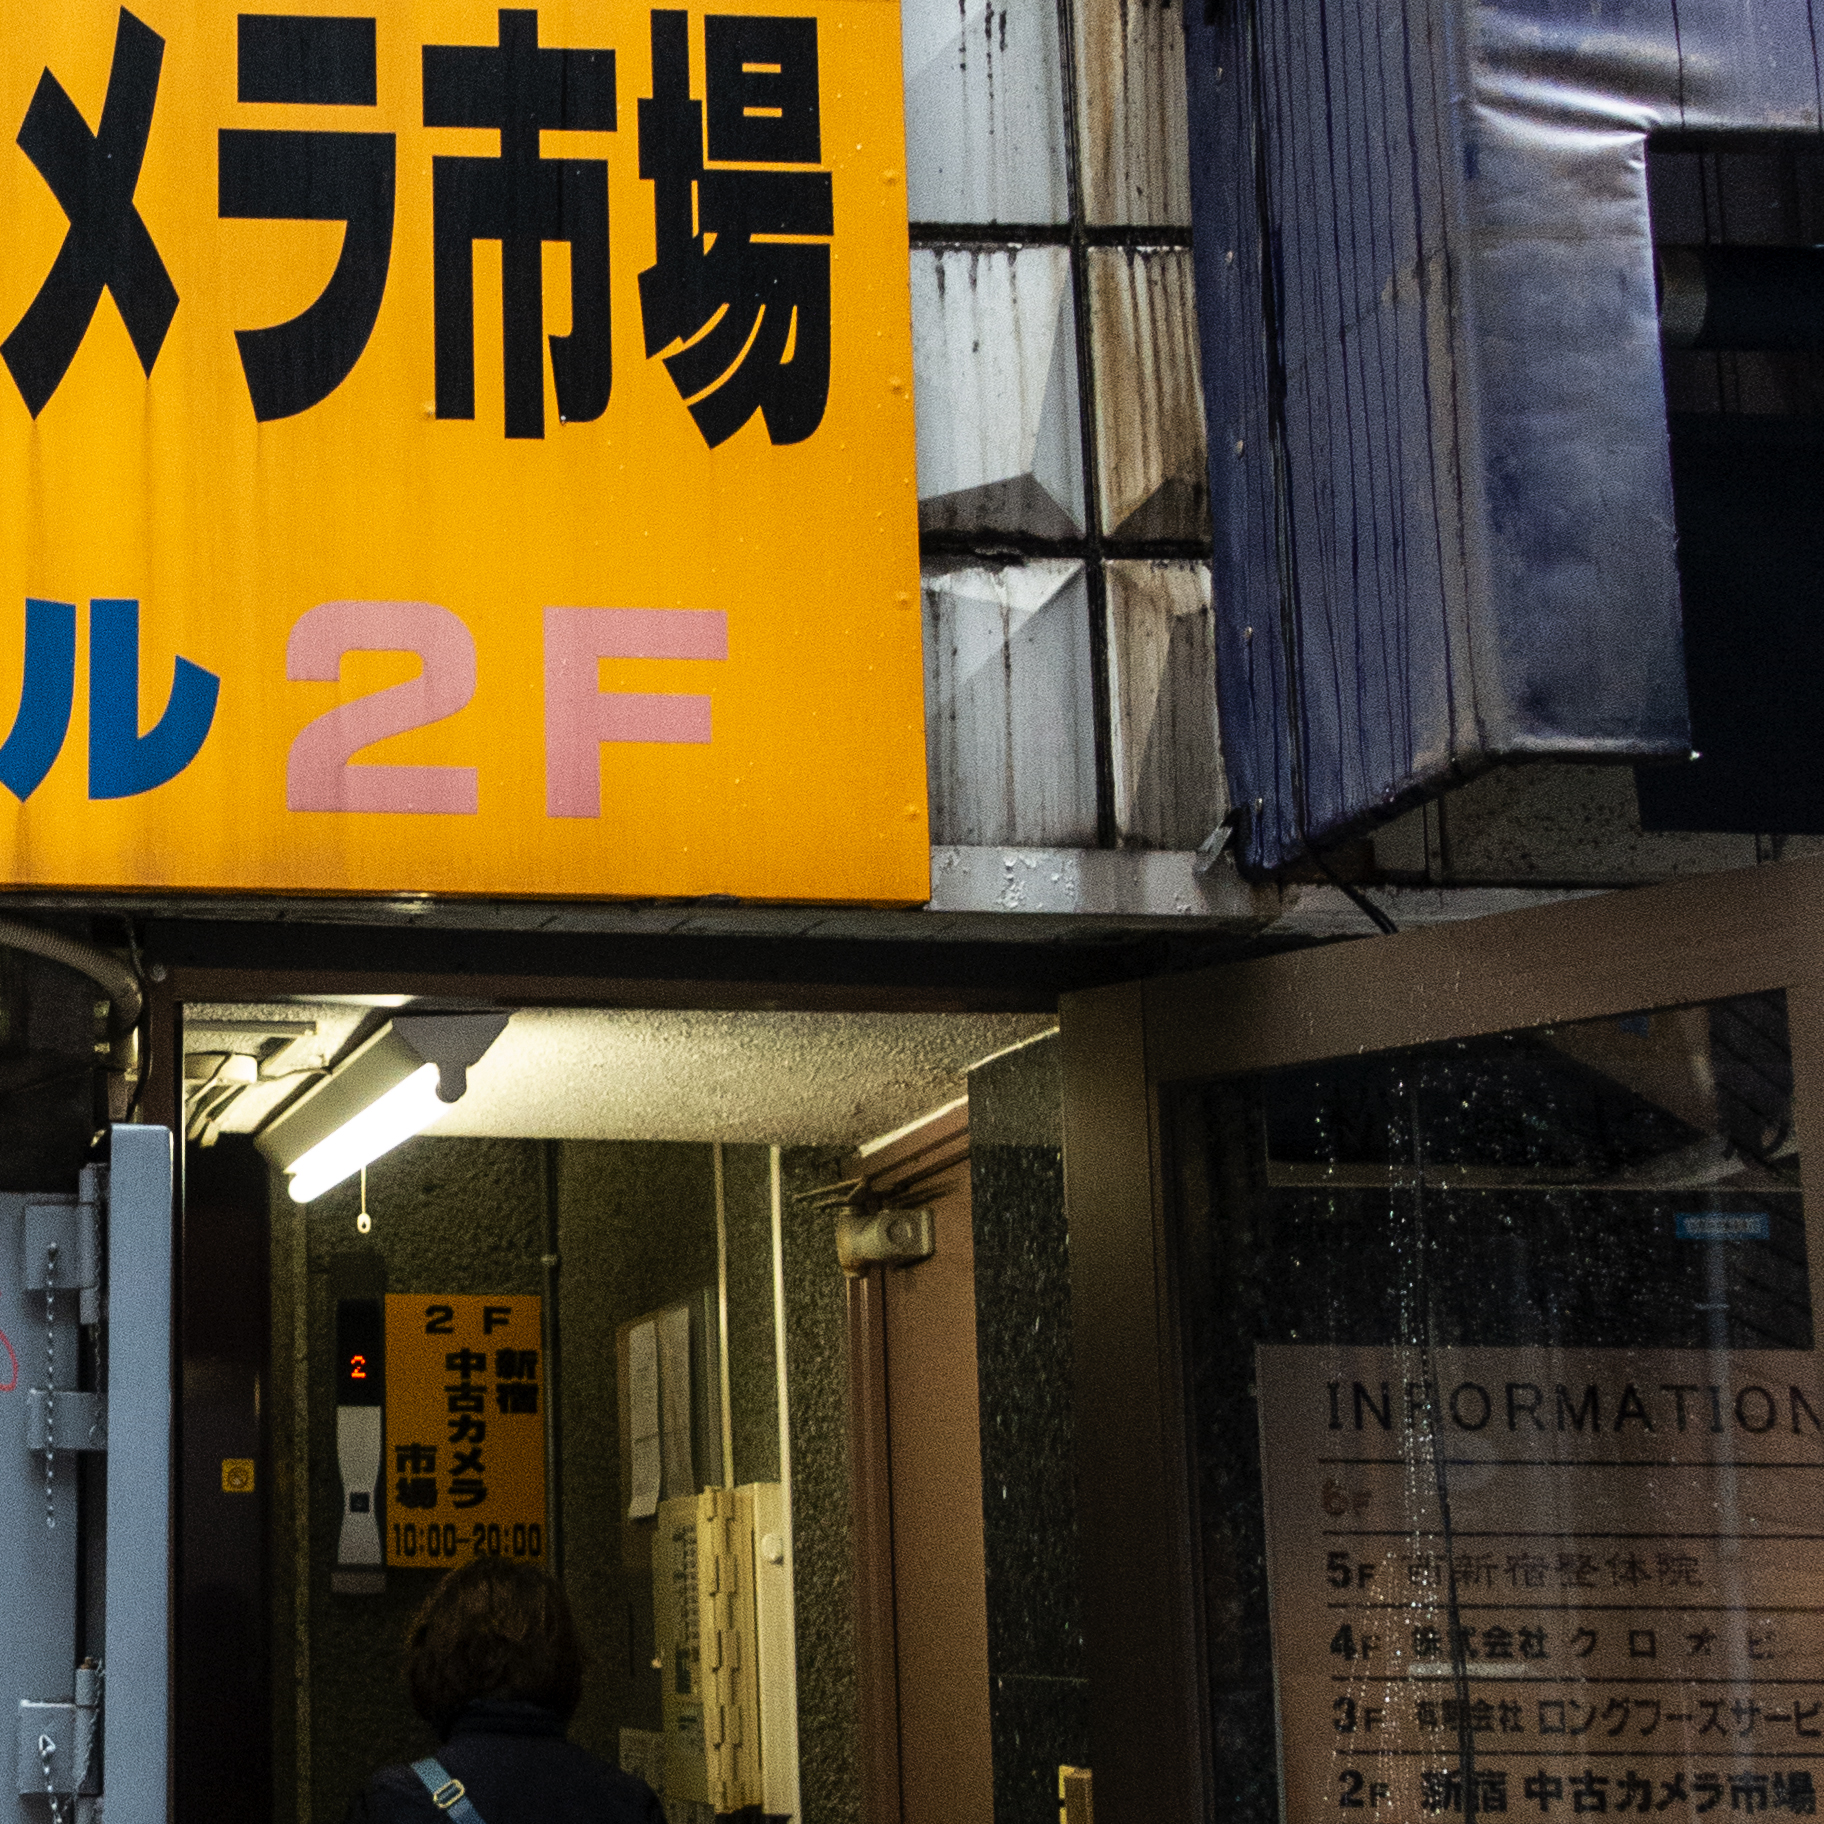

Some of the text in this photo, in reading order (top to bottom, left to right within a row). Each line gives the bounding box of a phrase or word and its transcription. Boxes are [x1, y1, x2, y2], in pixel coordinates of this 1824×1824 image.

[283, 599, 730, 819] 2F
[350, 1354, 368, 1379] 2
[1327, 1382, 1824, 1434] INFORMATION
[1326, 1551, 1375, 1589] 5F
[1329, 1623, 1382, 1660] 4F
[1331, 1697, 1385, 1732] 3F
[1338, 1770, 1816, 1815] 2F 新宿 中古カメラ市場
